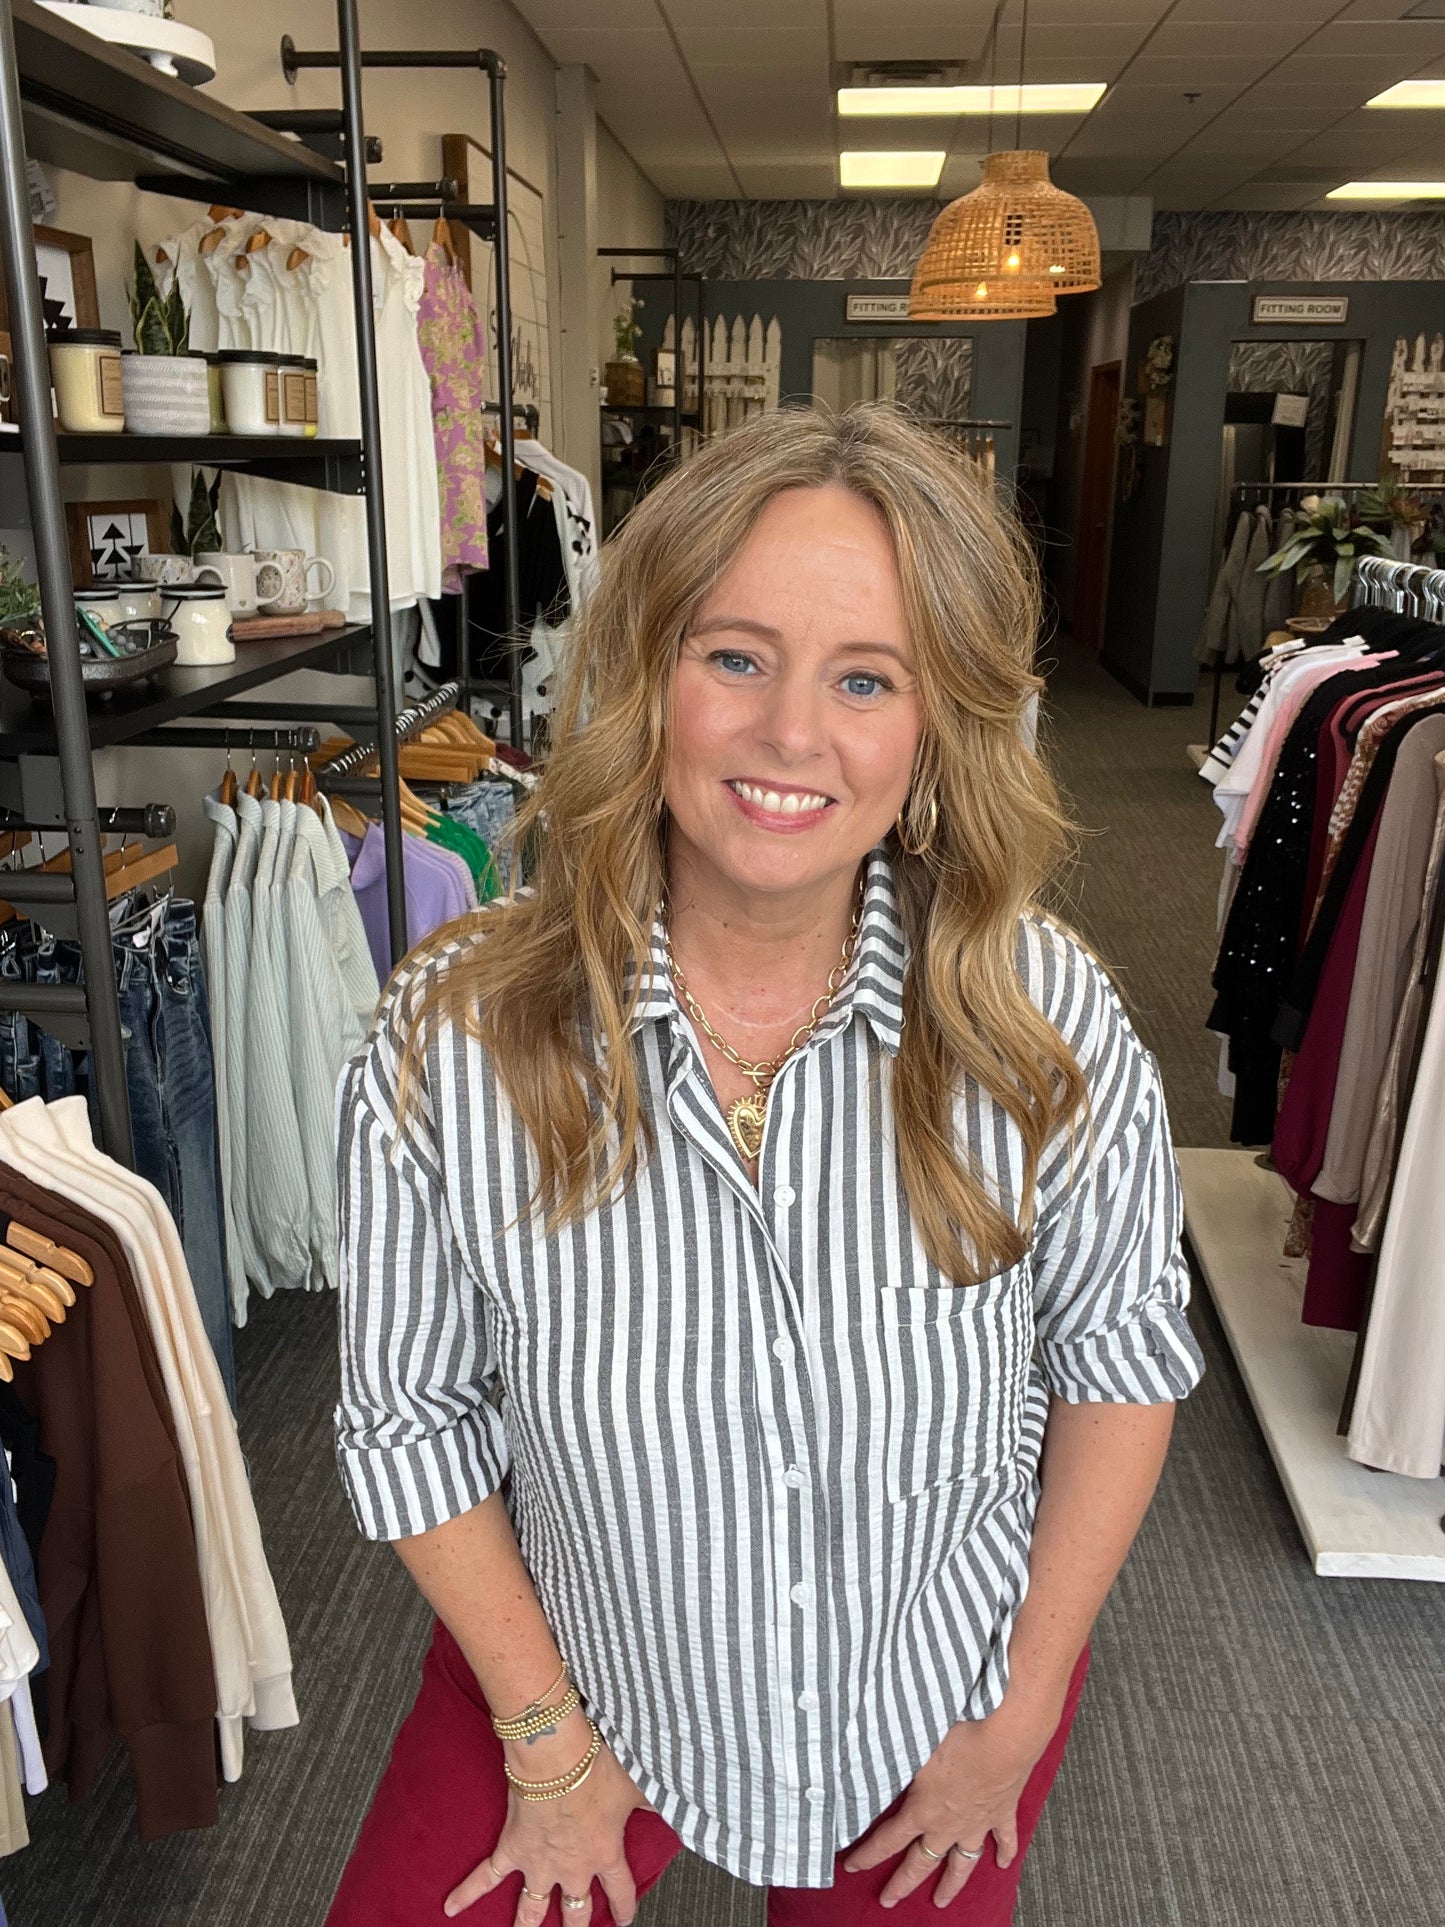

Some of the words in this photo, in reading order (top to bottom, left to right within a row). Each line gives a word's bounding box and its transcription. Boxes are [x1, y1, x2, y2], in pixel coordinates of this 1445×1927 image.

[853, 303, 897, 312] FITTING
[1261, 304, 1304, 313] FITTING
[1307, 304, 1341, 314] ROOM
